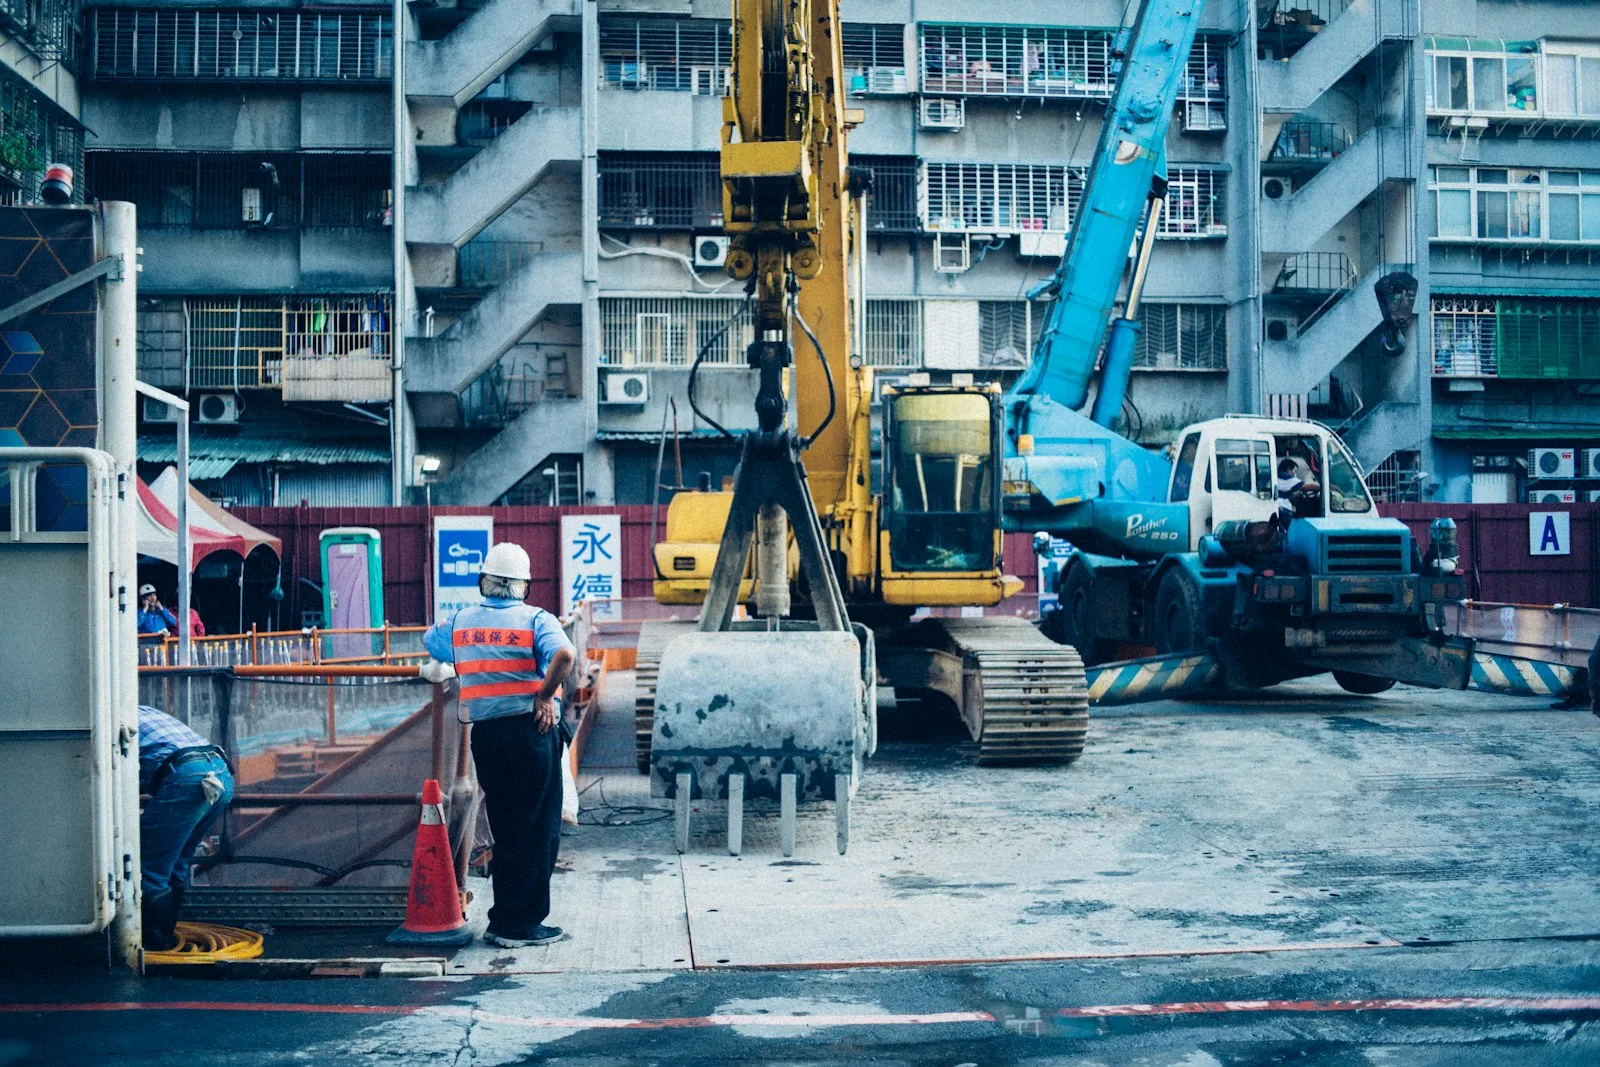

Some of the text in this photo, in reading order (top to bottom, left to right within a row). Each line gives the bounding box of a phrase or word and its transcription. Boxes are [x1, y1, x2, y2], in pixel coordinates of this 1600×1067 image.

[1125, 513, 1168, 538] Panther
[1541, 515, 1560, 551] A
[572, 523, 612, 614] 永續
